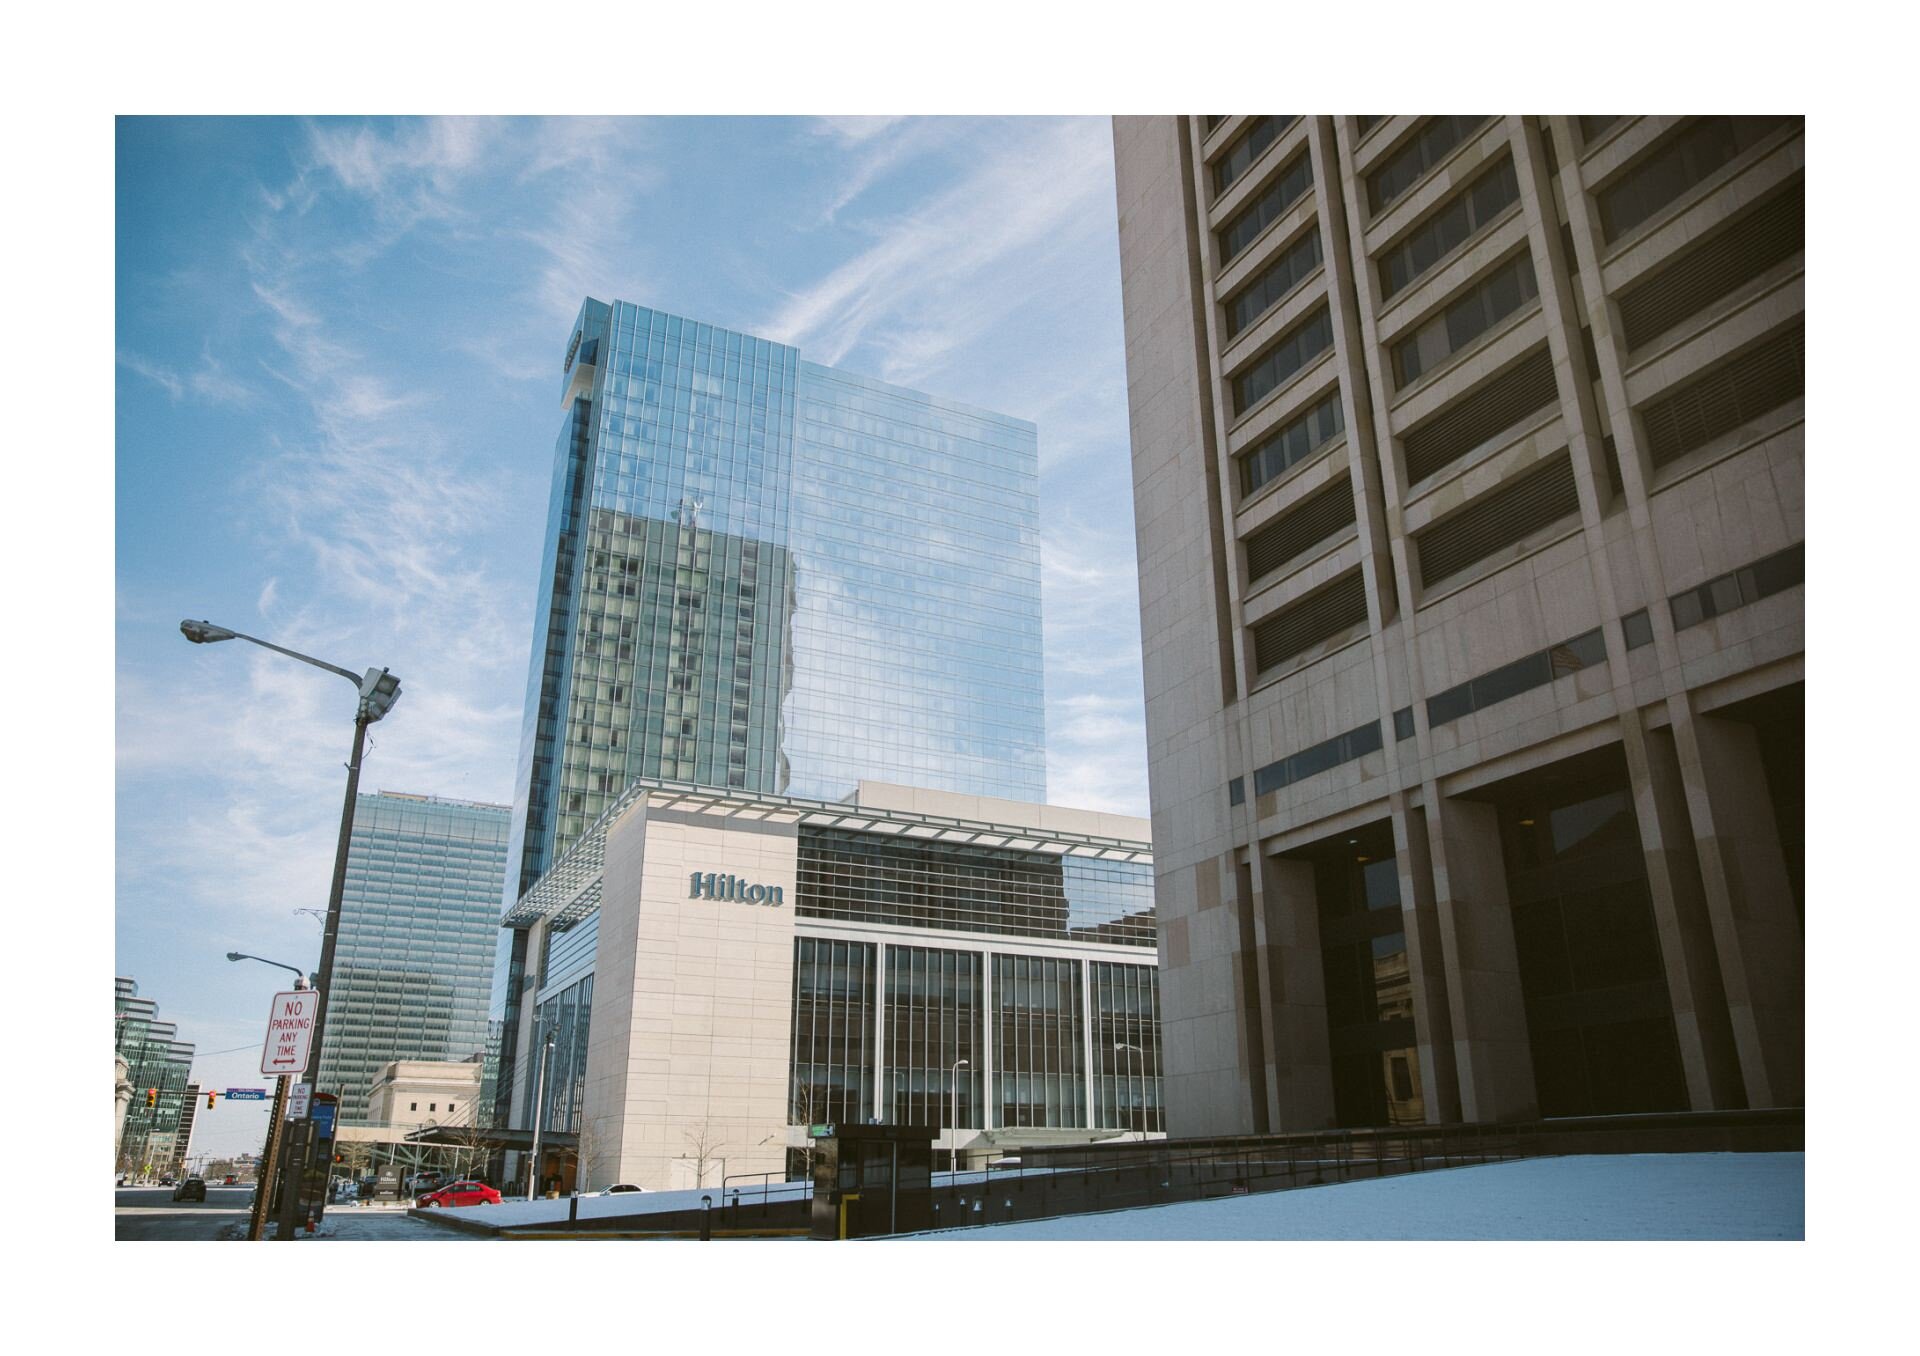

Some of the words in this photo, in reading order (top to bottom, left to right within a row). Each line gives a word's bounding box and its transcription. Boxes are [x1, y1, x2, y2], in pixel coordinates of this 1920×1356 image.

[688, 871, 784, 907] Hilton
[285, 1001, 303, 1016] NO
[272, 1019, 310, 1030] PARKING
[279, 1032, 298, 1043] ANY
[276, 1045, 297, 1056] TIME
